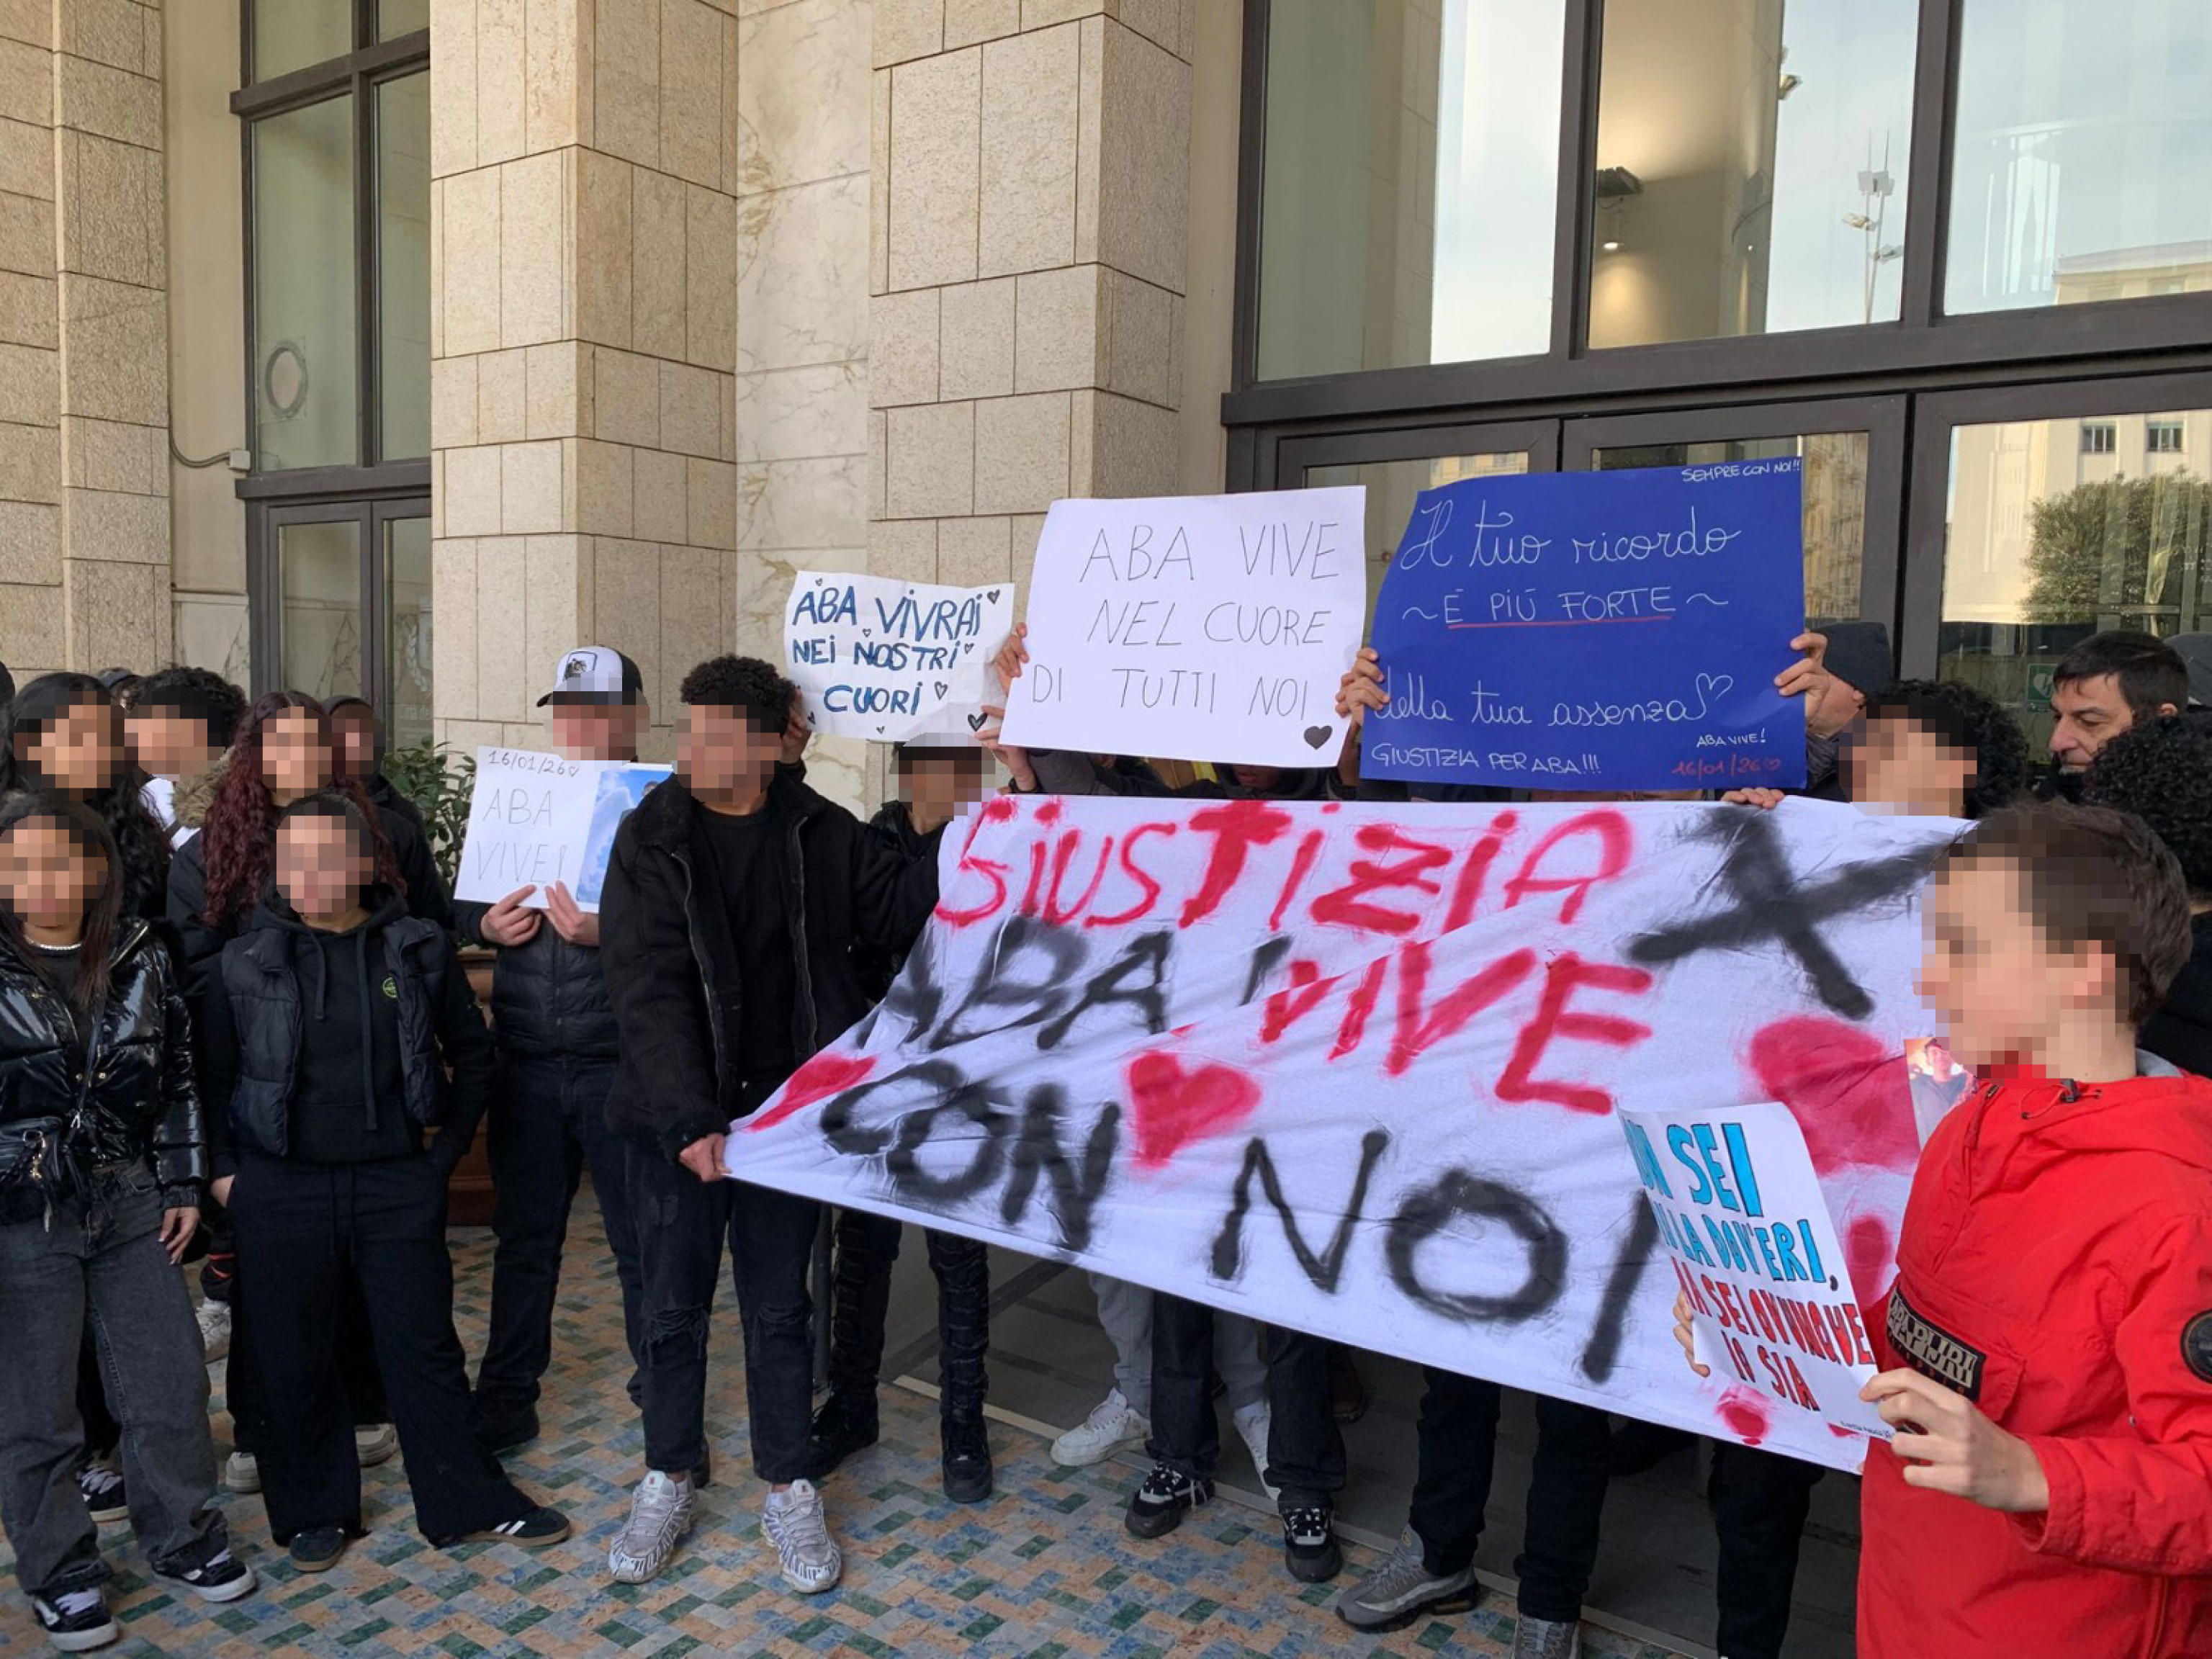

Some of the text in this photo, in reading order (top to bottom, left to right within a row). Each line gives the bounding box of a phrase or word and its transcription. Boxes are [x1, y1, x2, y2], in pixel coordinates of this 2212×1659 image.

[1743, 463, 1770, 476] CON
[1080, 521, 1339, 583] ABA VIVE
[1469, 500, 1552, 567] tuo
[1573, 505, 1742, 564] ricordo
[792, 586, 858, 626] ABA
[1087, 599, 1331, 646] NEL CUORE
[1557, 586, 1676, 621] FORTE
[1032, 665, 1308, 720] DI TUTTI NOI
[1470, 680, 1533, 724] tua
[1548, 700, 1694, 727] assenza
[488, 750, 565, 775] 16/01/26
[1371, 742, 1480, 768] GIUSTIZIA
[1488, 753, 1527, 770] PER
[1696, 734, 1727, 748] ABA
[482, 788, 552, 827] ABA
[1626, 805, 1951, 1021] X
[1666, 1123, 1764, 1218] SEI
[819, 1058, 1659, 1382] CON NOI
[1700, 1273, 1760, 1338] SEI
[1757, 1344, 1821, 1412] SIA
